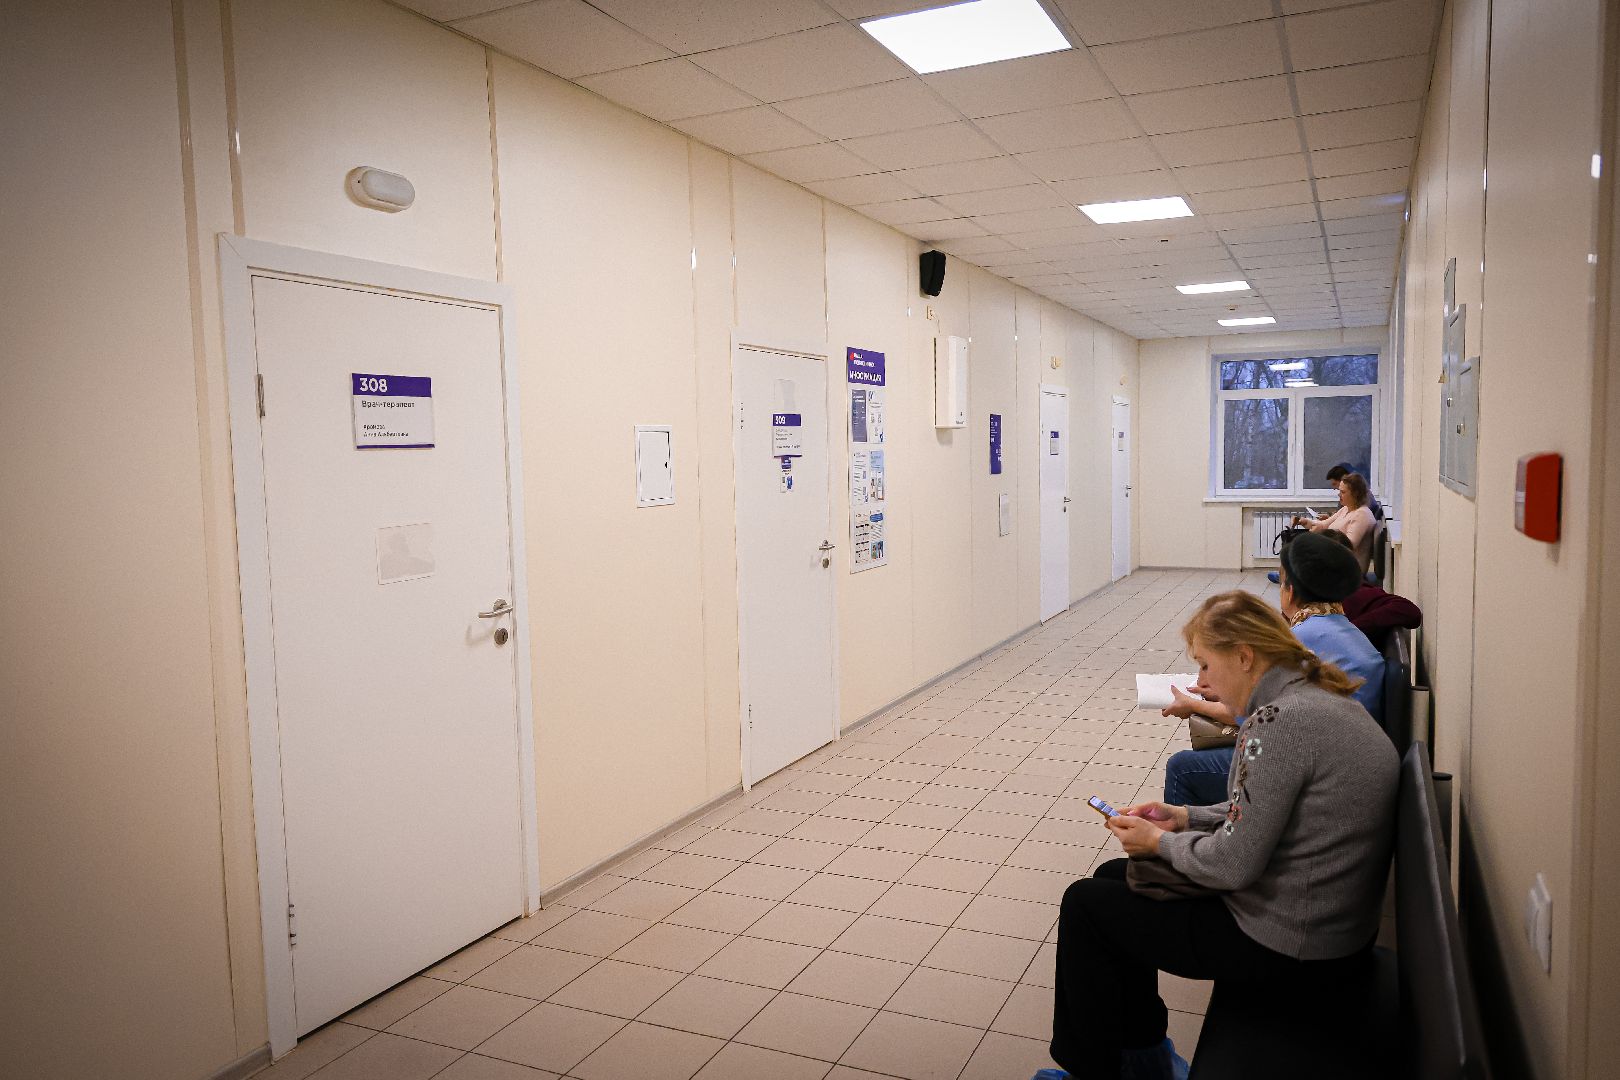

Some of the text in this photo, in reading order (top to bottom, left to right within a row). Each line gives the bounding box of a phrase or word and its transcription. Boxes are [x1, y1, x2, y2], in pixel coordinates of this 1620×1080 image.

[359, 377, 388, 393] 308
[361, 400, 415, 409] Врач-терапевт
[775, 416, 786, 425] 309
